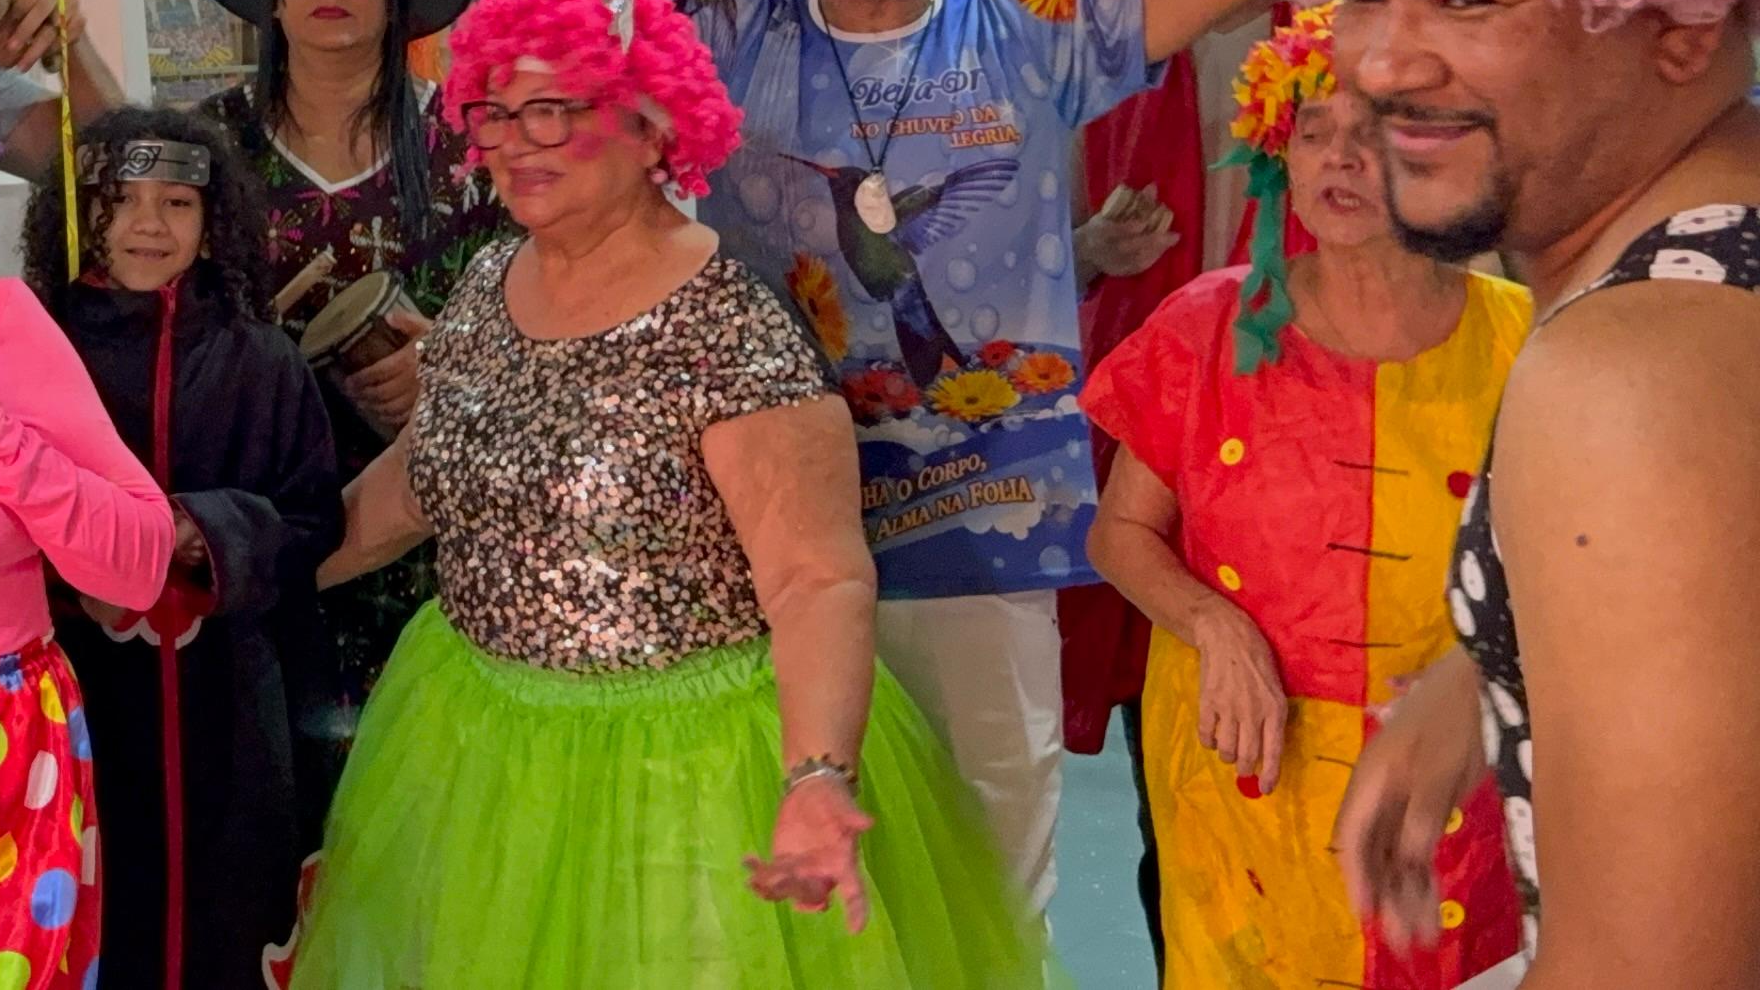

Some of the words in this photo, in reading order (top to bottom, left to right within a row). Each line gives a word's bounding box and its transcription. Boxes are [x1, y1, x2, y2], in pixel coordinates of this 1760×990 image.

[897, 478, 912, 501] O
[917, 453, 987, 491] CORPO,
[876, 506, 932, 541] ALMA
[936, 495, 965, 517] NA
[968, 477, 1034, 507] FOLIA
